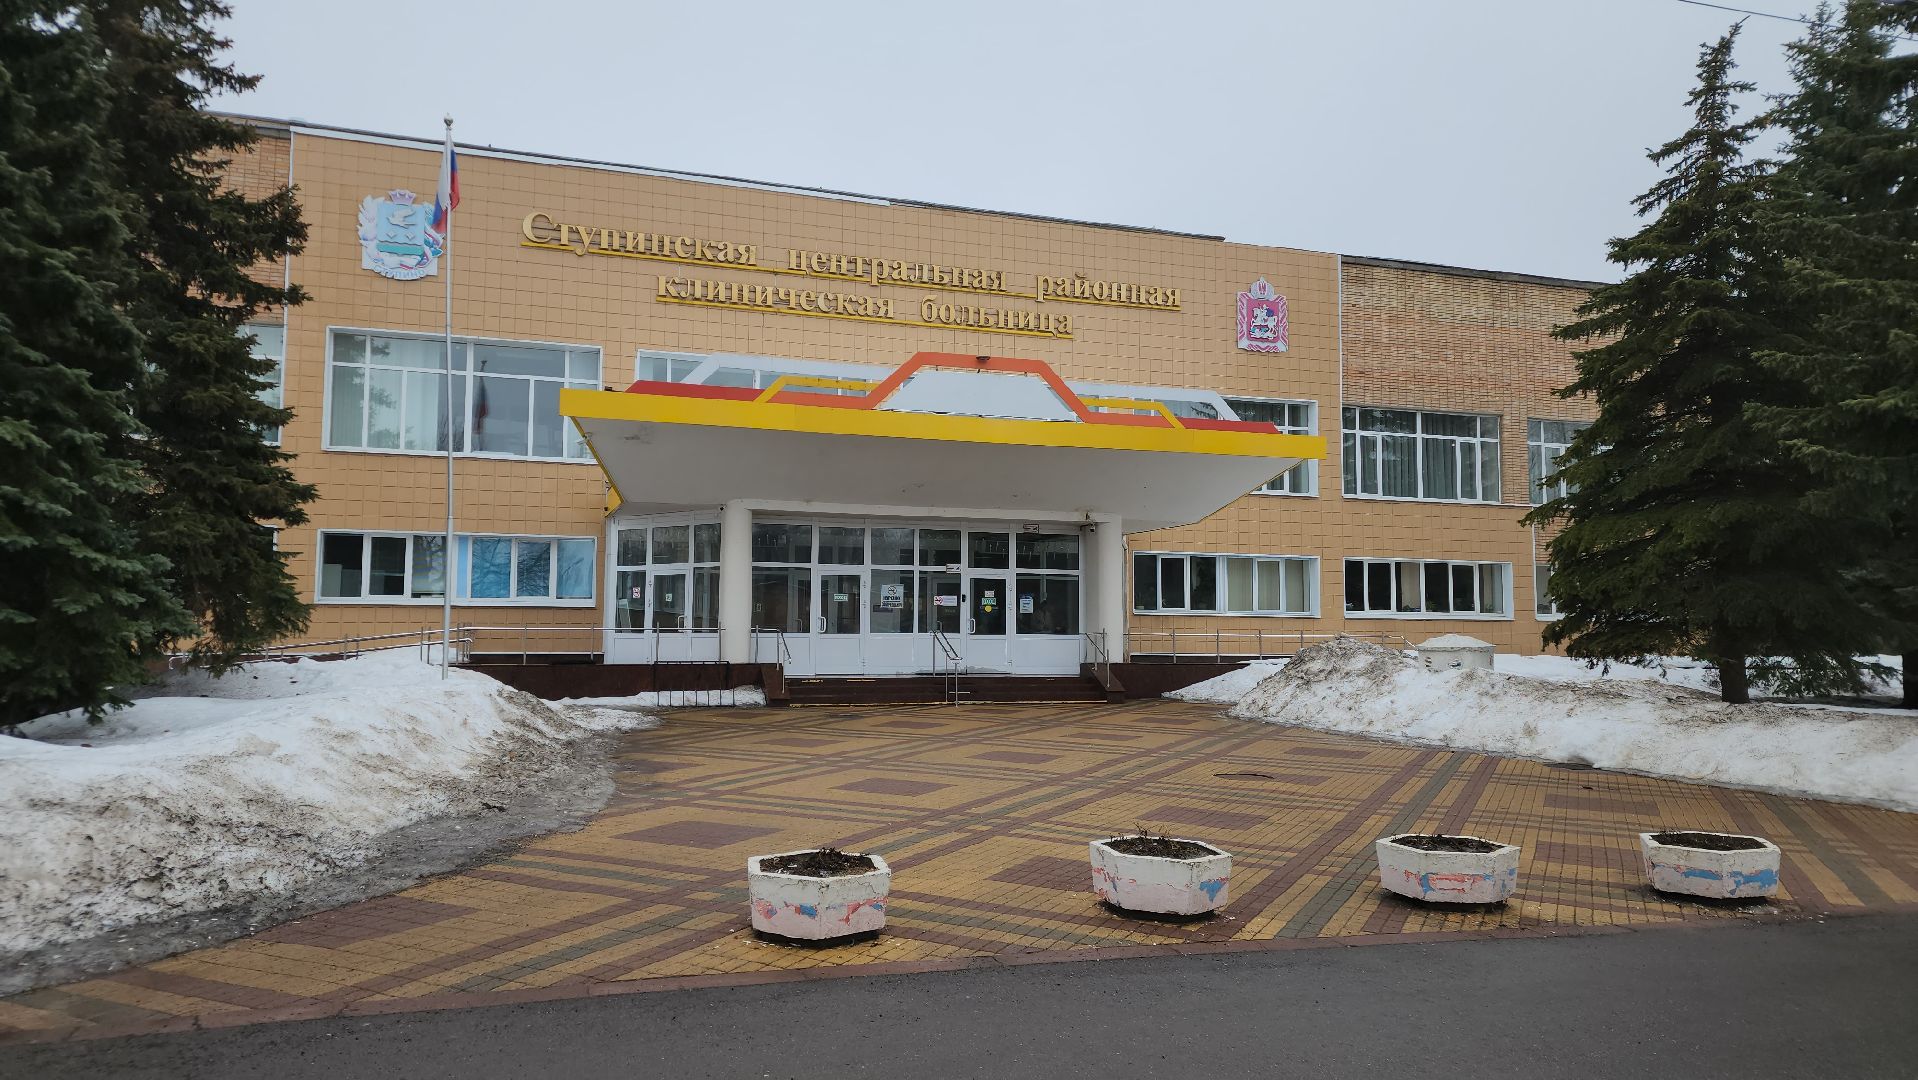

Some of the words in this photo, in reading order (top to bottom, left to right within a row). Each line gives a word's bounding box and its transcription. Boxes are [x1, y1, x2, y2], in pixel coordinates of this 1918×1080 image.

[522, 211, 757, 266] Ступинская
[788, 249, 1007, 291] центральная
[1035, 271, 1182, 306] районная
[657, 275, 894, 318] клиническая
[921, 294, 1074, 336] больница
